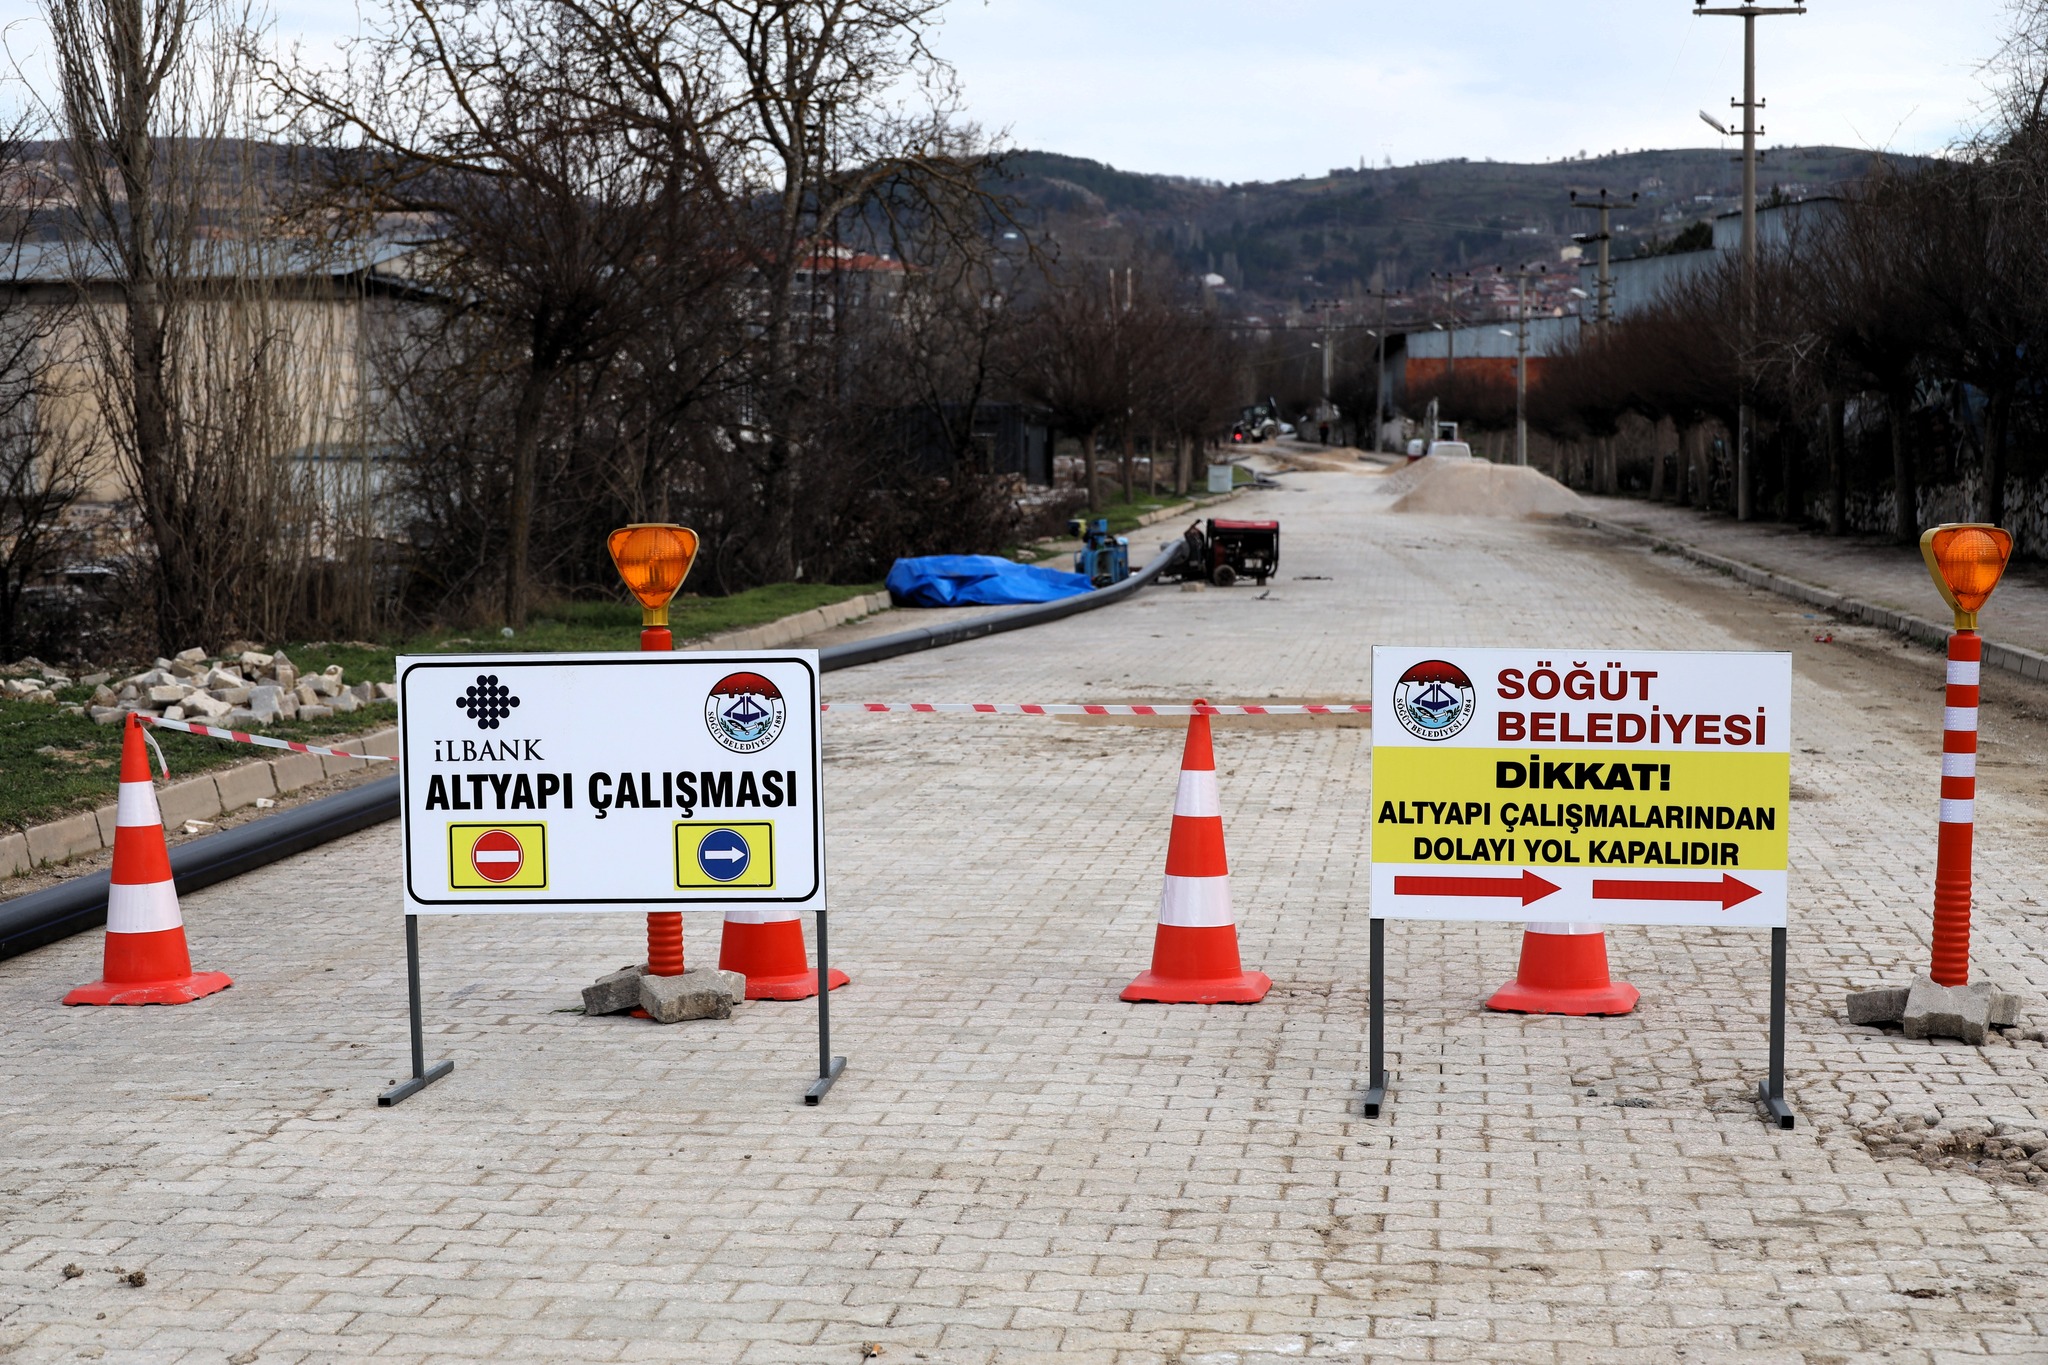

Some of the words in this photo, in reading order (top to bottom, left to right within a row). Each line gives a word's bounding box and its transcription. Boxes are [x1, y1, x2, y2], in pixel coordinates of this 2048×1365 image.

[1497, 661, 1658, 702] SÖĞÜT
[1464, 699, 1472, 717] 1884
[1497, 705, 1765, 746] BELEDİYESİ
[1496, 754, 1671, 791] DİKKAT!
[425, 773, 573, 811] ALTYAPI
[588, 770, 797, 819] ÇALIŞMASI
[1378, 801, 1491, 826] ALTYAPI
[1500, 802, 1775, 834] ÇALIŞMALARINDAN
[1414, 837, 1515, 862] DOLAYI
[1523, 839, 1580, 863] YOL
[1588, 840, 1739, 866] KAPALIDIR
